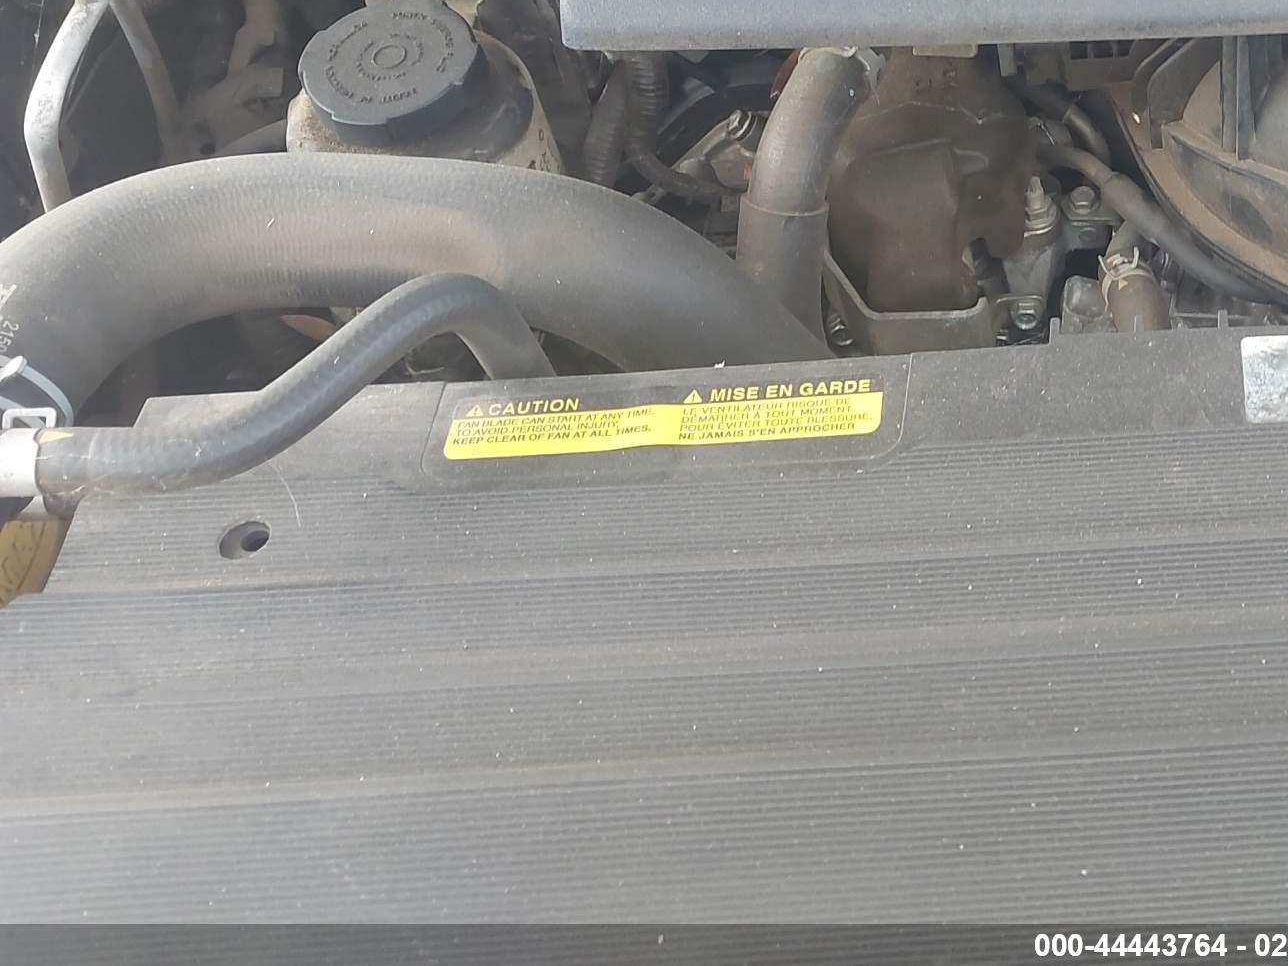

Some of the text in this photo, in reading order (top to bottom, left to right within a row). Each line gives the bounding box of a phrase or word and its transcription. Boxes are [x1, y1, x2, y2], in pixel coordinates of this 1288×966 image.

[710, 379, 871, 402] MISE EN GARDE
[488, 398, 579, 416] CAUTION
[683, 397, 850, 416] LE VENTILATEUR RISQUE DE
[766, 409, 795, 418] TOUT
[800, 406, 851, 416] MOMENT
[458, 420, 480, 429] FAN
[482, 418, 517, 428] BLADE
[521, 416, 546, 426] CAN
[548, 414, 585, 424] START
[585, 413, 599, 422] AT
[600, 412, 623, 421] ANY
[679, 423, 714, 431] POUR
[766, 417, 803, 427] TOUTE
[453, 424, 651, 445] KEEP CLEAR OF FAN AT ALL TIMES.
[457, 429, 471, 437] TO
[473, 427, 508, 436] AVOID
[511, 423, 572, 434] PERSONAL
[679, 422, 855, 440] NE JAMAIS S'EN APPROCHER
